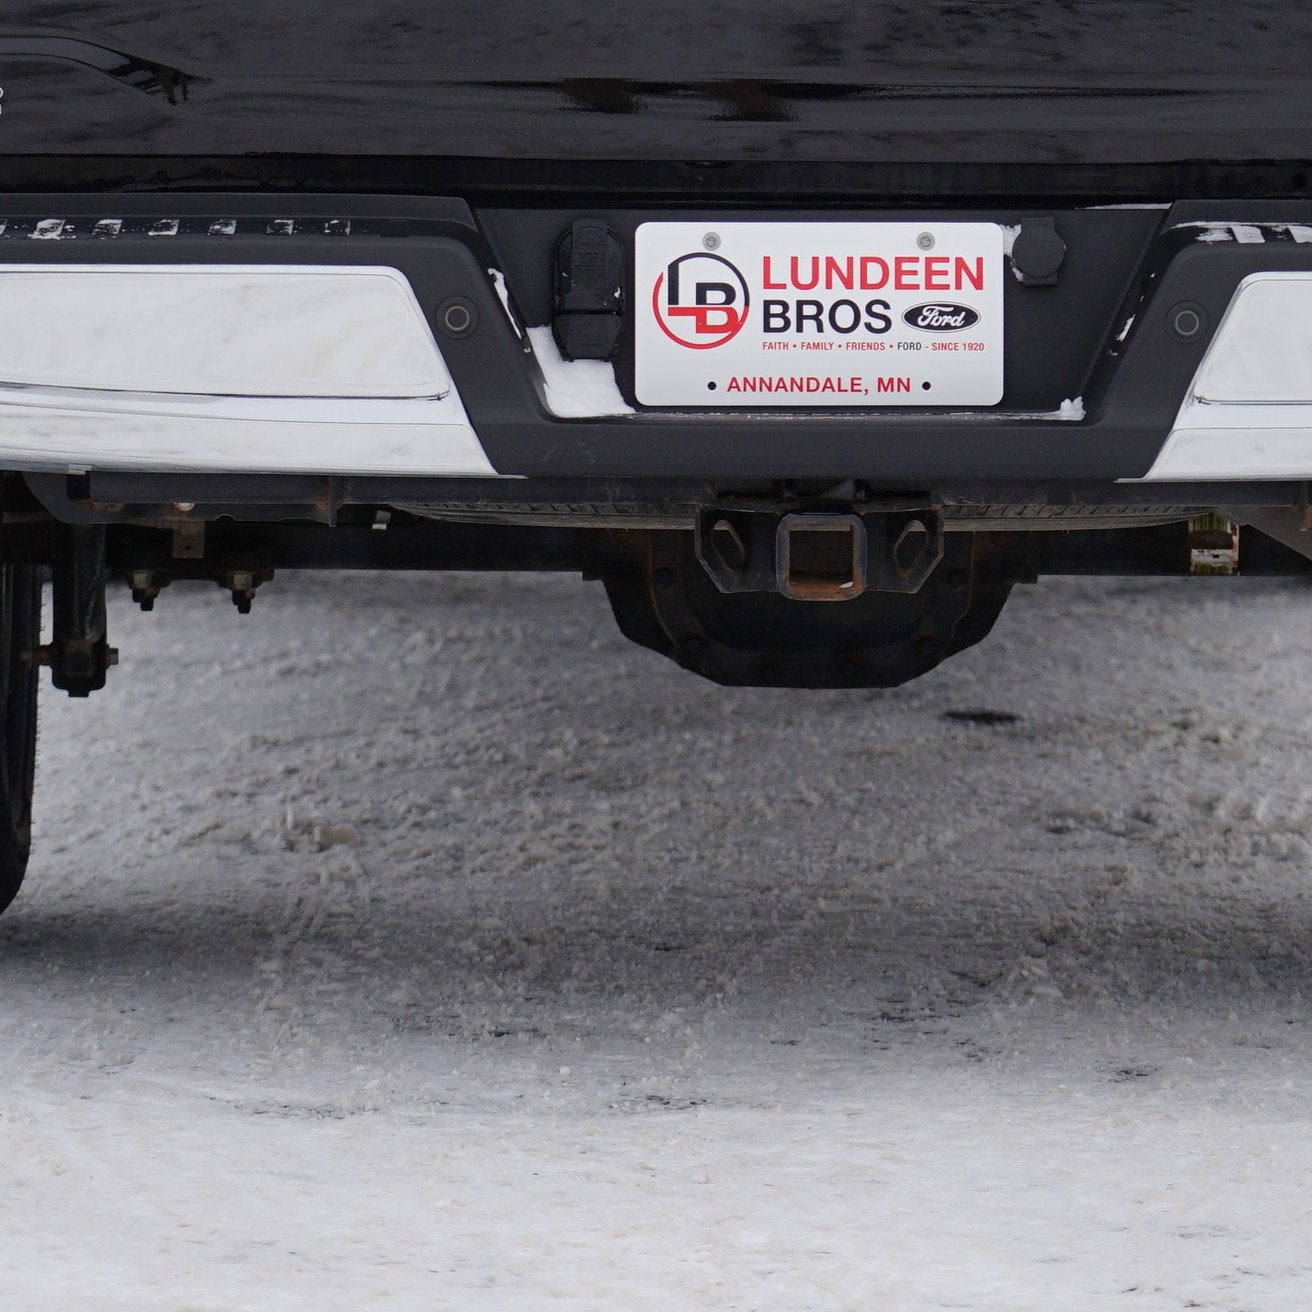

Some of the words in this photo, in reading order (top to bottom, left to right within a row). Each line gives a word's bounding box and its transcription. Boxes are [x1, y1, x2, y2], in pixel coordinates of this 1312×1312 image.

[763, 256, 983, 290] LUNDEEN
[763, 299, 892, 334] BROS
[762, 341, 789, 351] FAITH
[800, 341, 834, 351] FAMILY
[846, 341, 886, 351] FRIENDS
[897, 341, 922, 351] FORD
[931, 341, 959, 351] SINCE
[963, 341, 985, 351] 1920
[727, 377, 869, 395] ANNANDALE,
[877, 377, 910, 392] MN
